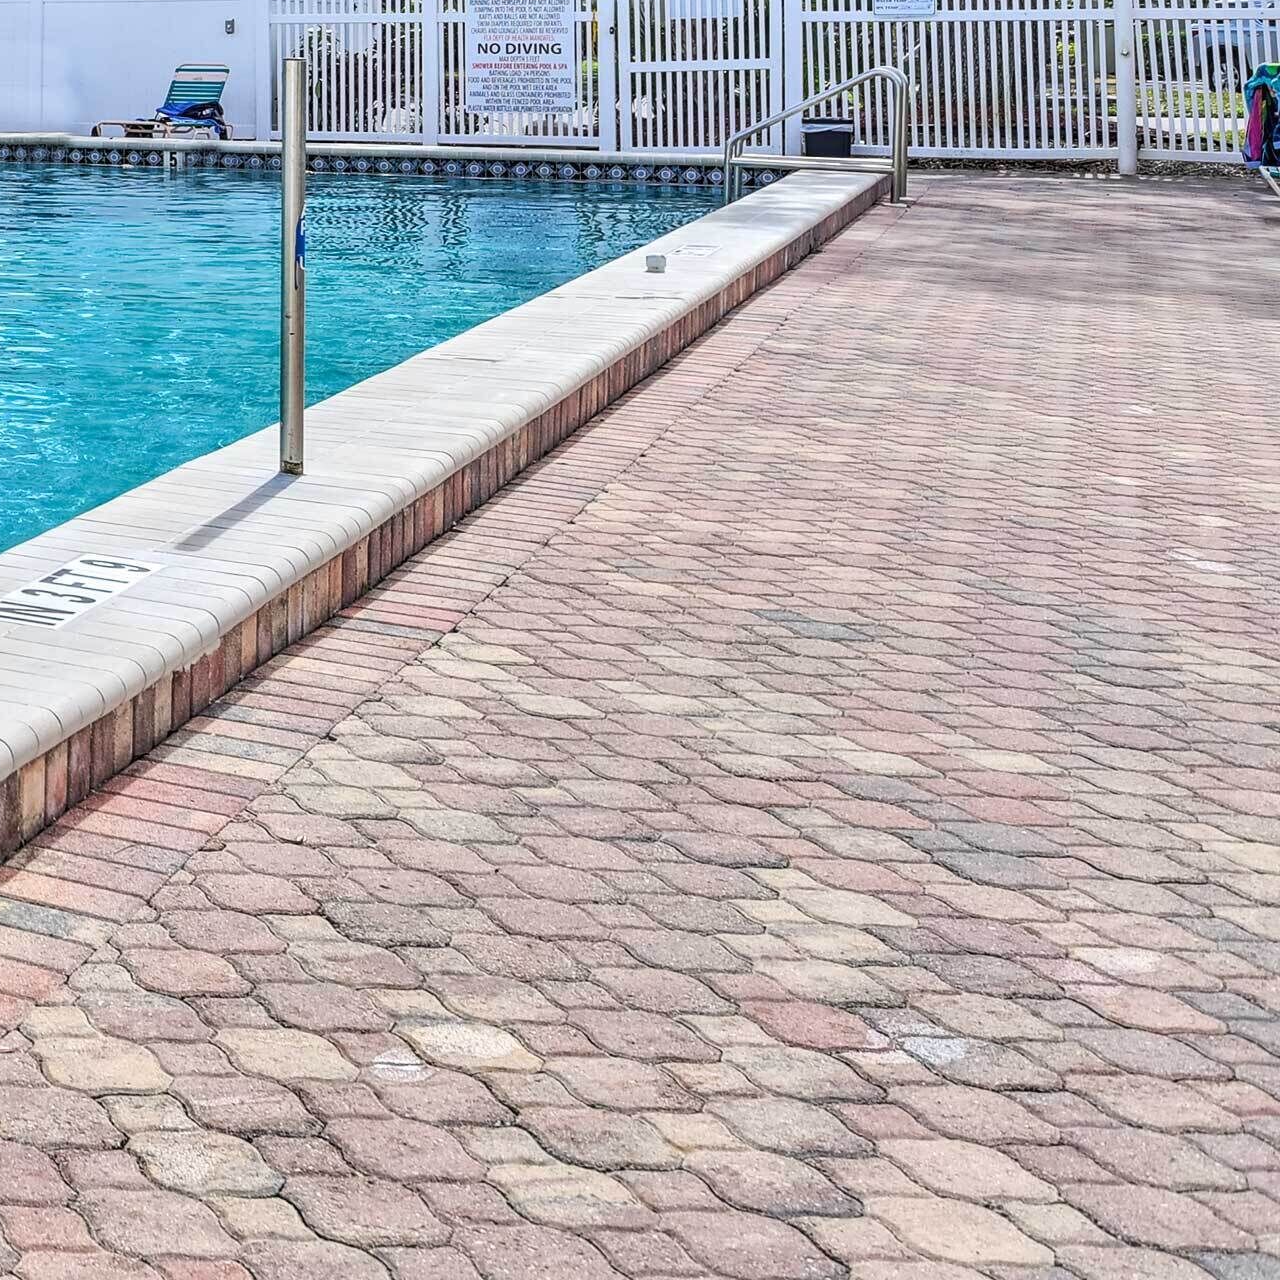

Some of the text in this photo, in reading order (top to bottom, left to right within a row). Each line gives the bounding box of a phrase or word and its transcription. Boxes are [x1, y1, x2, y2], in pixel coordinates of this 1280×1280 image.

[478, 43, 562, 54] NO DIVING
[80, 559, 151, 572] 9
[40, 569, 129, 593] FT
[22, 589, 96, 604] 3
